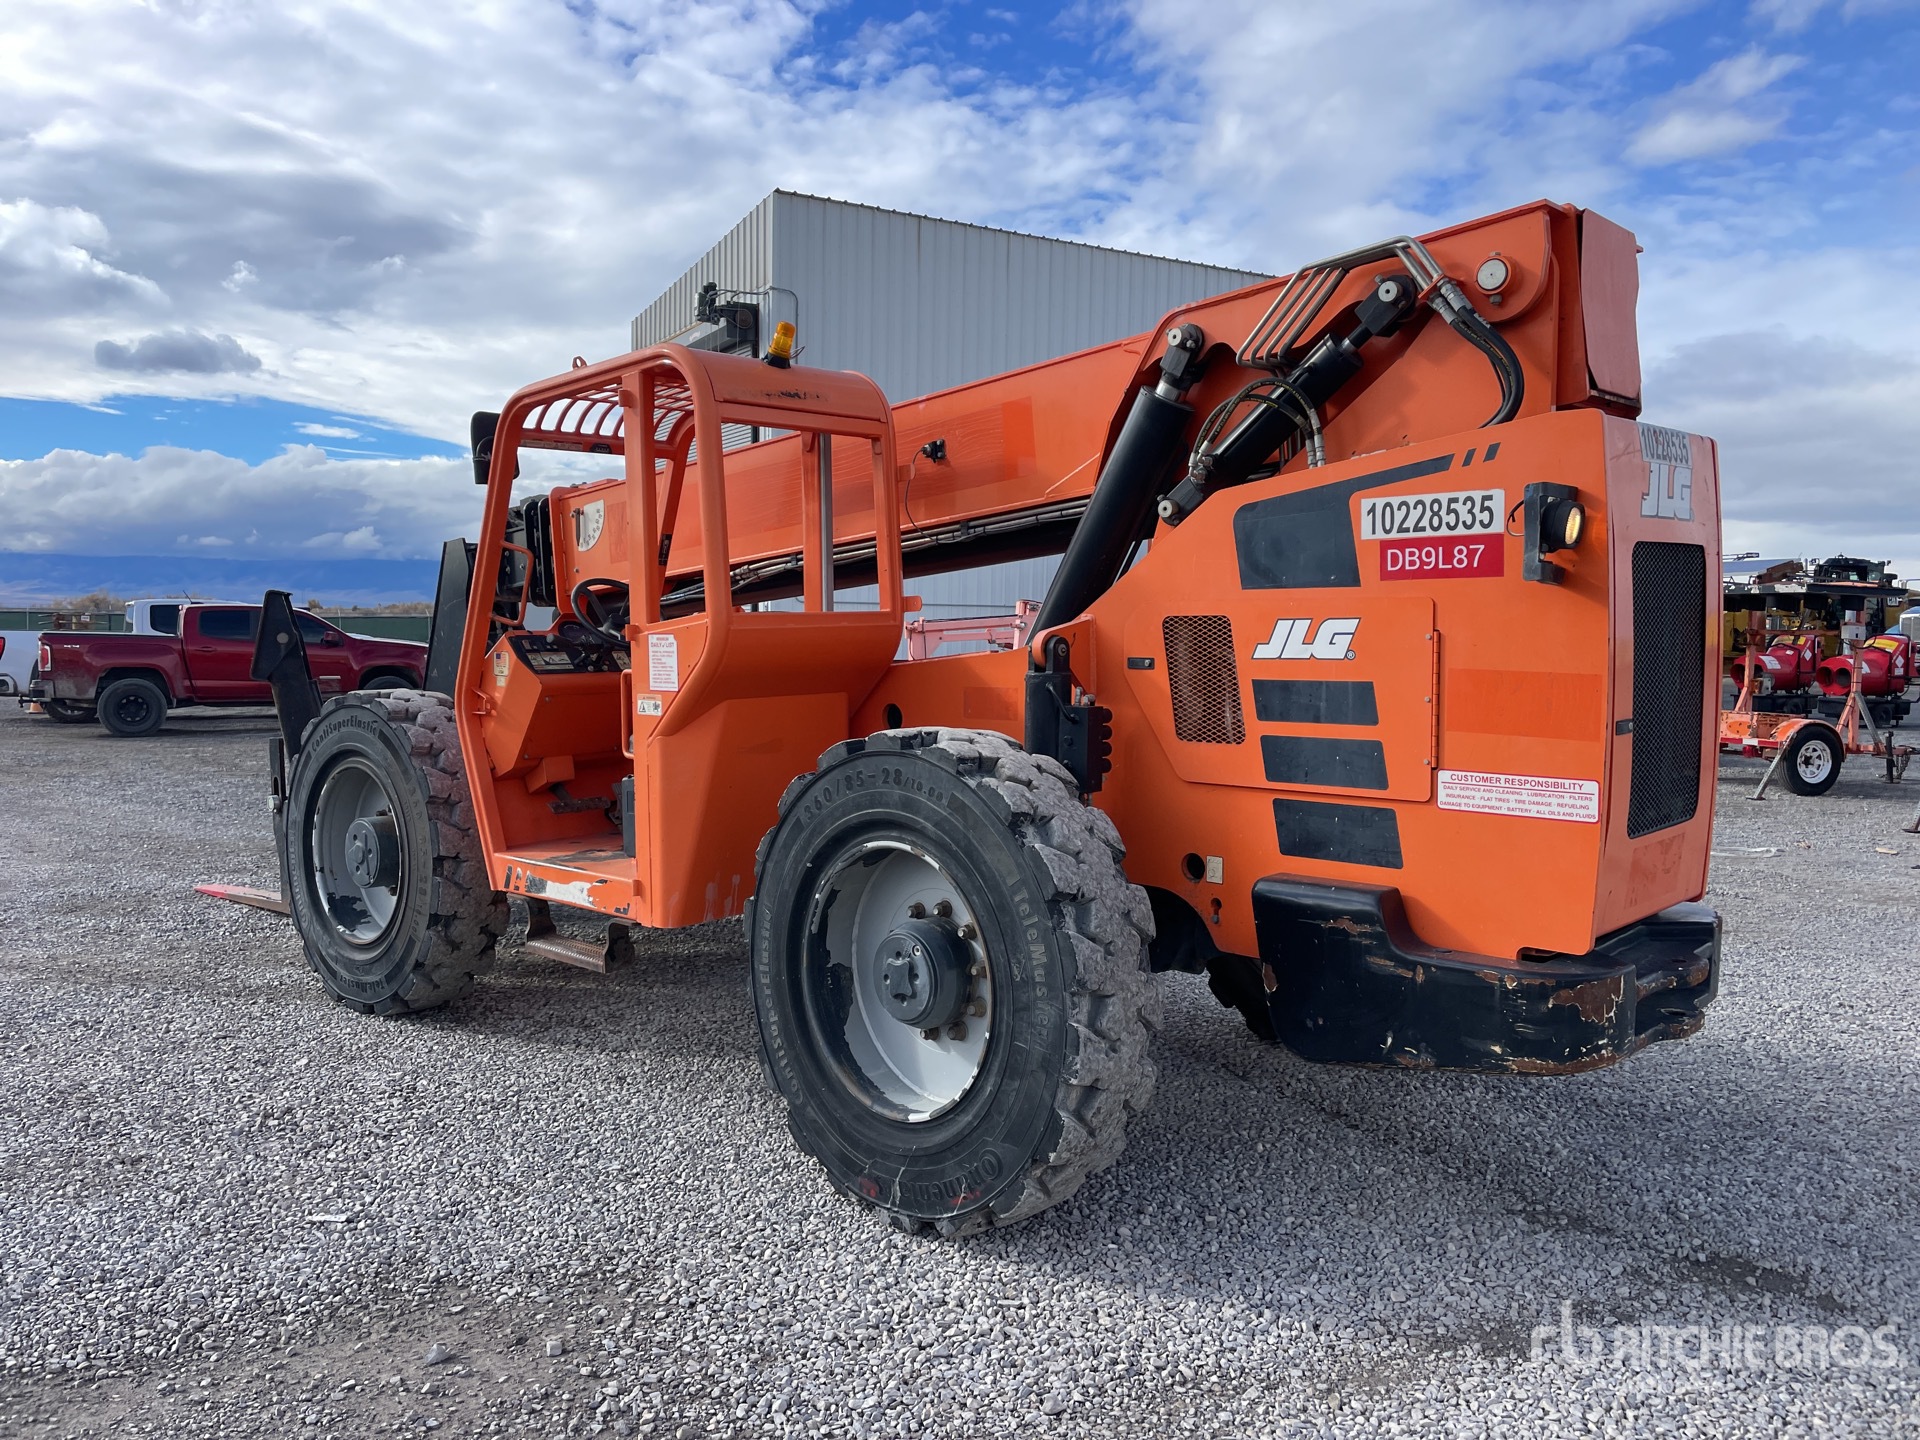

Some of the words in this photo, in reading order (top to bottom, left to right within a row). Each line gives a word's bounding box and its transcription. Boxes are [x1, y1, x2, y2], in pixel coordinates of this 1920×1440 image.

[1640, 461, 1692, 522] JLG
[1366, 494, 1494, 535] 10228535
[1387, 544, 1485, 571] DB9L87
[1251, 617, 1361, 660] JLG
[1450, 773, 1502, 785] CUSTOMER
[1504, 777, 1584, 791] RESPONSIBILITY
[1495, 788, 1523, 796] CLEANING
[1527, 791, 1565, 799] LUBRICATION
[1471, 803, 1502, 811] EQUIPMENT
[1557, 802, 1589, 810] REFUELING
